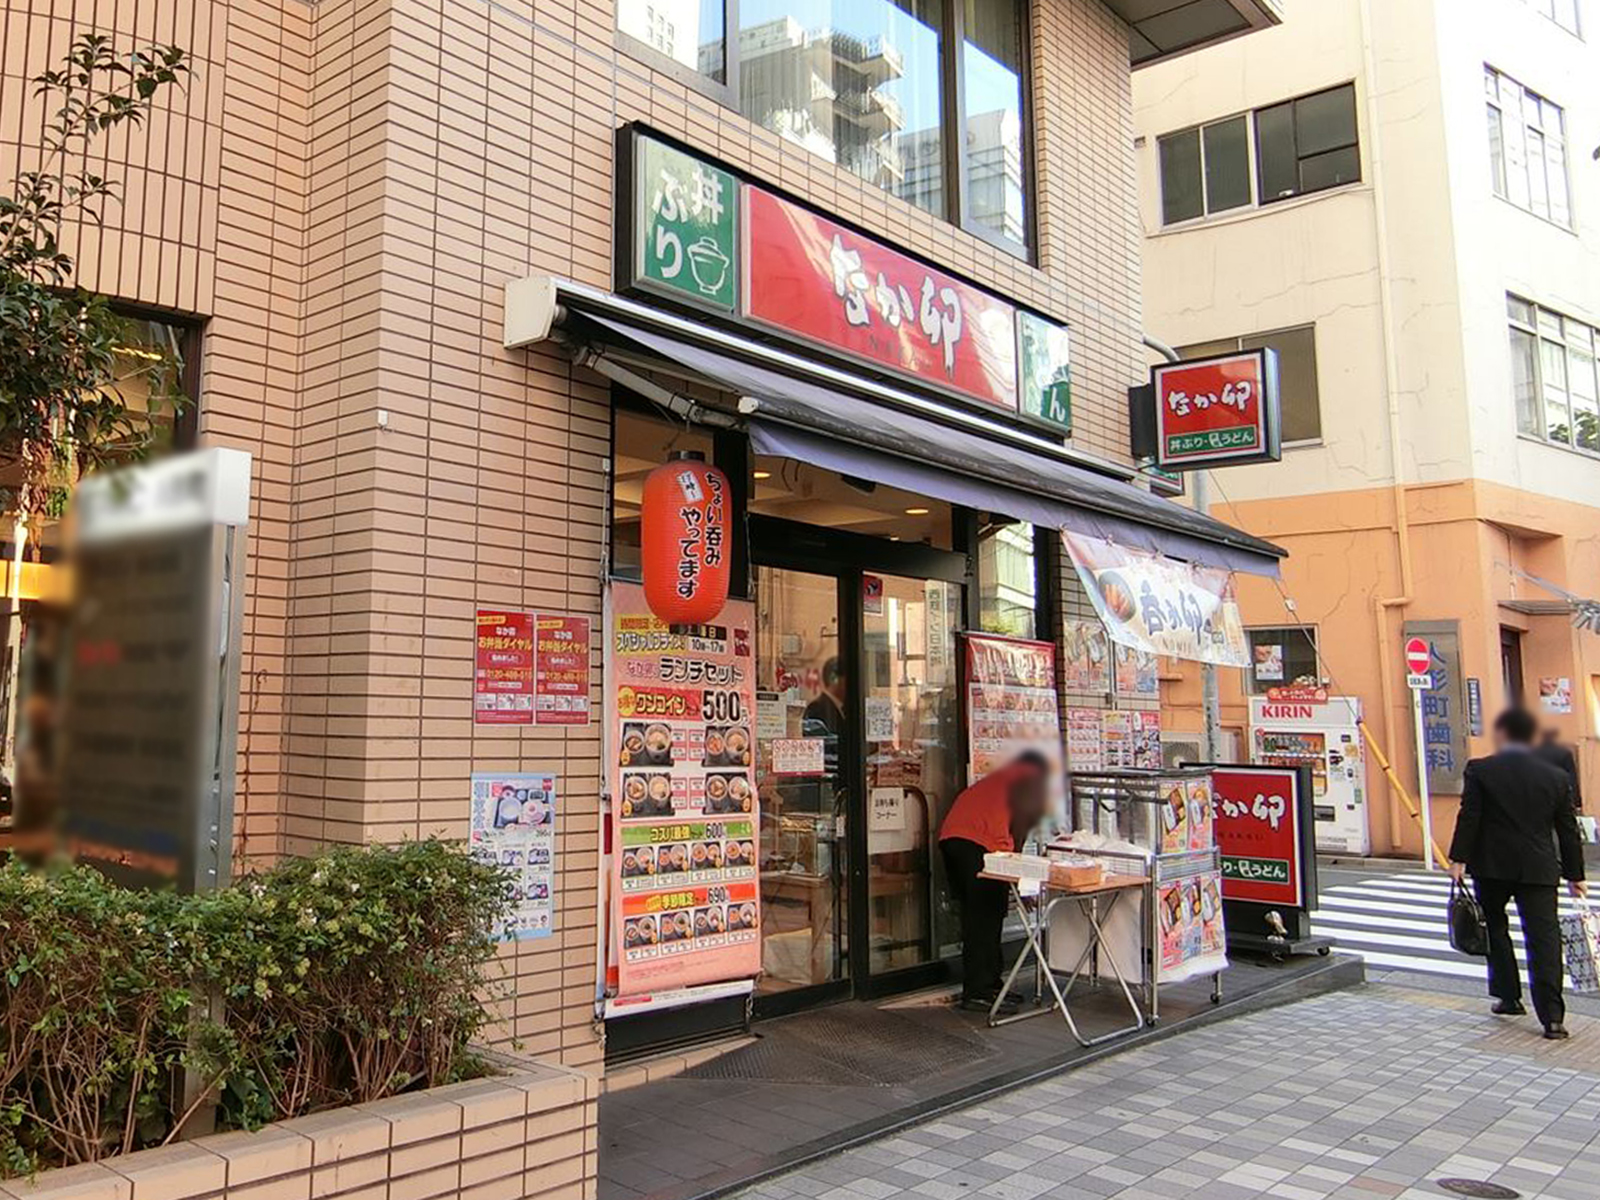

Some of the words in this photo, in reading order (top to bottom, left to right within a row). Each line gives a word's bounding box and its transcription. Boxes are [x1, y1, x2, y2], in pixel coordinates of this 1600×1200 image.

[829, 233, 962, 380] なか卯
[1167, 380, 1252, 417] なか卯
[705, 472, 723, 566] ちょい呑み
[678, 508, 702, 598] やってます
[660, 657, 743, 684] ランチセット
[636, 692, 686, 716] ワンコイン
[1261, 705, 1313, 719] KIRIN
